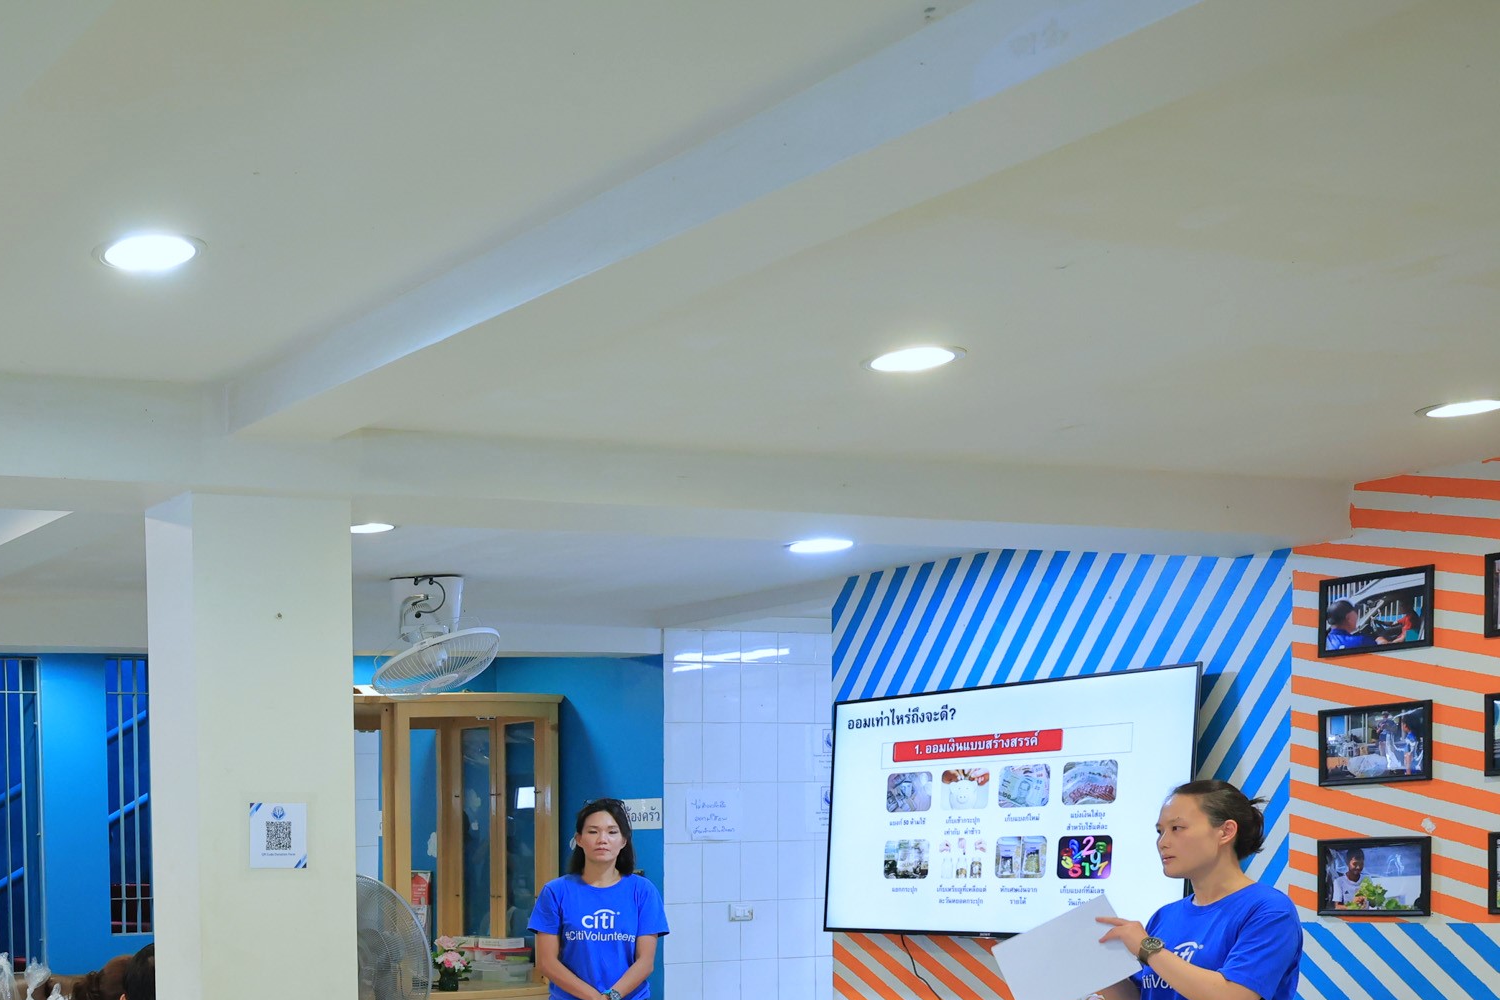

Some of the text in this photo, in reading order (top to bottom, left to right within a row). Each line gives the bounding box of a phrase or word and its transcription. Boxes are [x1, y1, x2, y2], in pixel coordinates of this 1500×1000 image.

[847, 704, 957, 730] ออมเท่าไหร่ถึงจะดี?
[914, 730, 1040, 755] 1. ออมเงินแบบสร้างสรรค์
[625, 806, 660, 822] ้องครัว
[581, 909, 617, 929] citi
[565, 931, 637, 943] #CitiVolunteers
